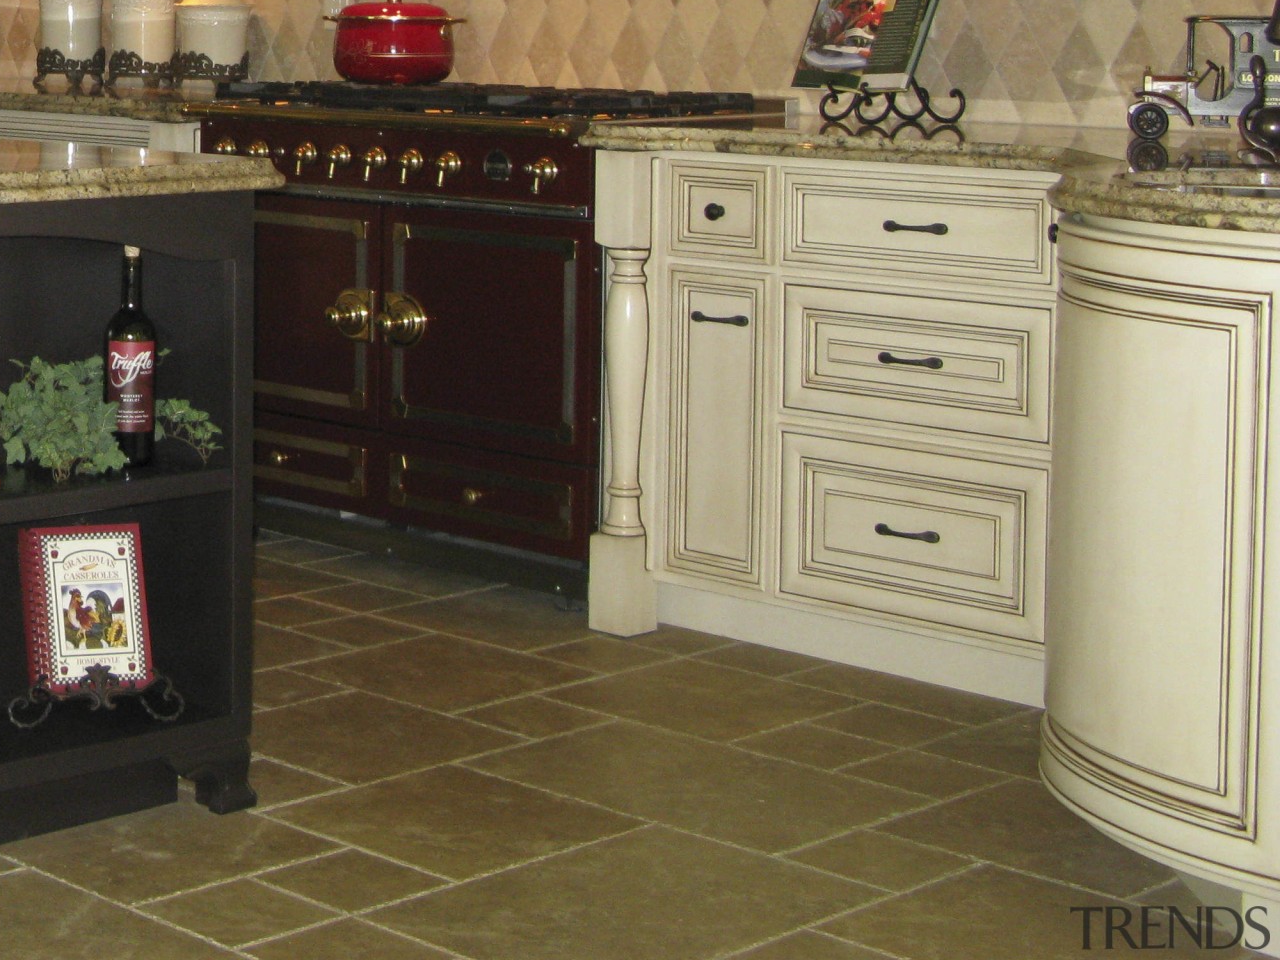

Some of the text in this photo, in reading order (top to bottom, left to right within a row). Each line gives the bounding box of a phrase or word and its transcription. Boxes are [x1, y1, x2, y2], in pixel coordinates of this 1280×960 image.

[1242, 73, 1280, 82] LOON
[111, 351, 153, 387] Truffle
[63, 571, 119, 581] CASSEROLES
